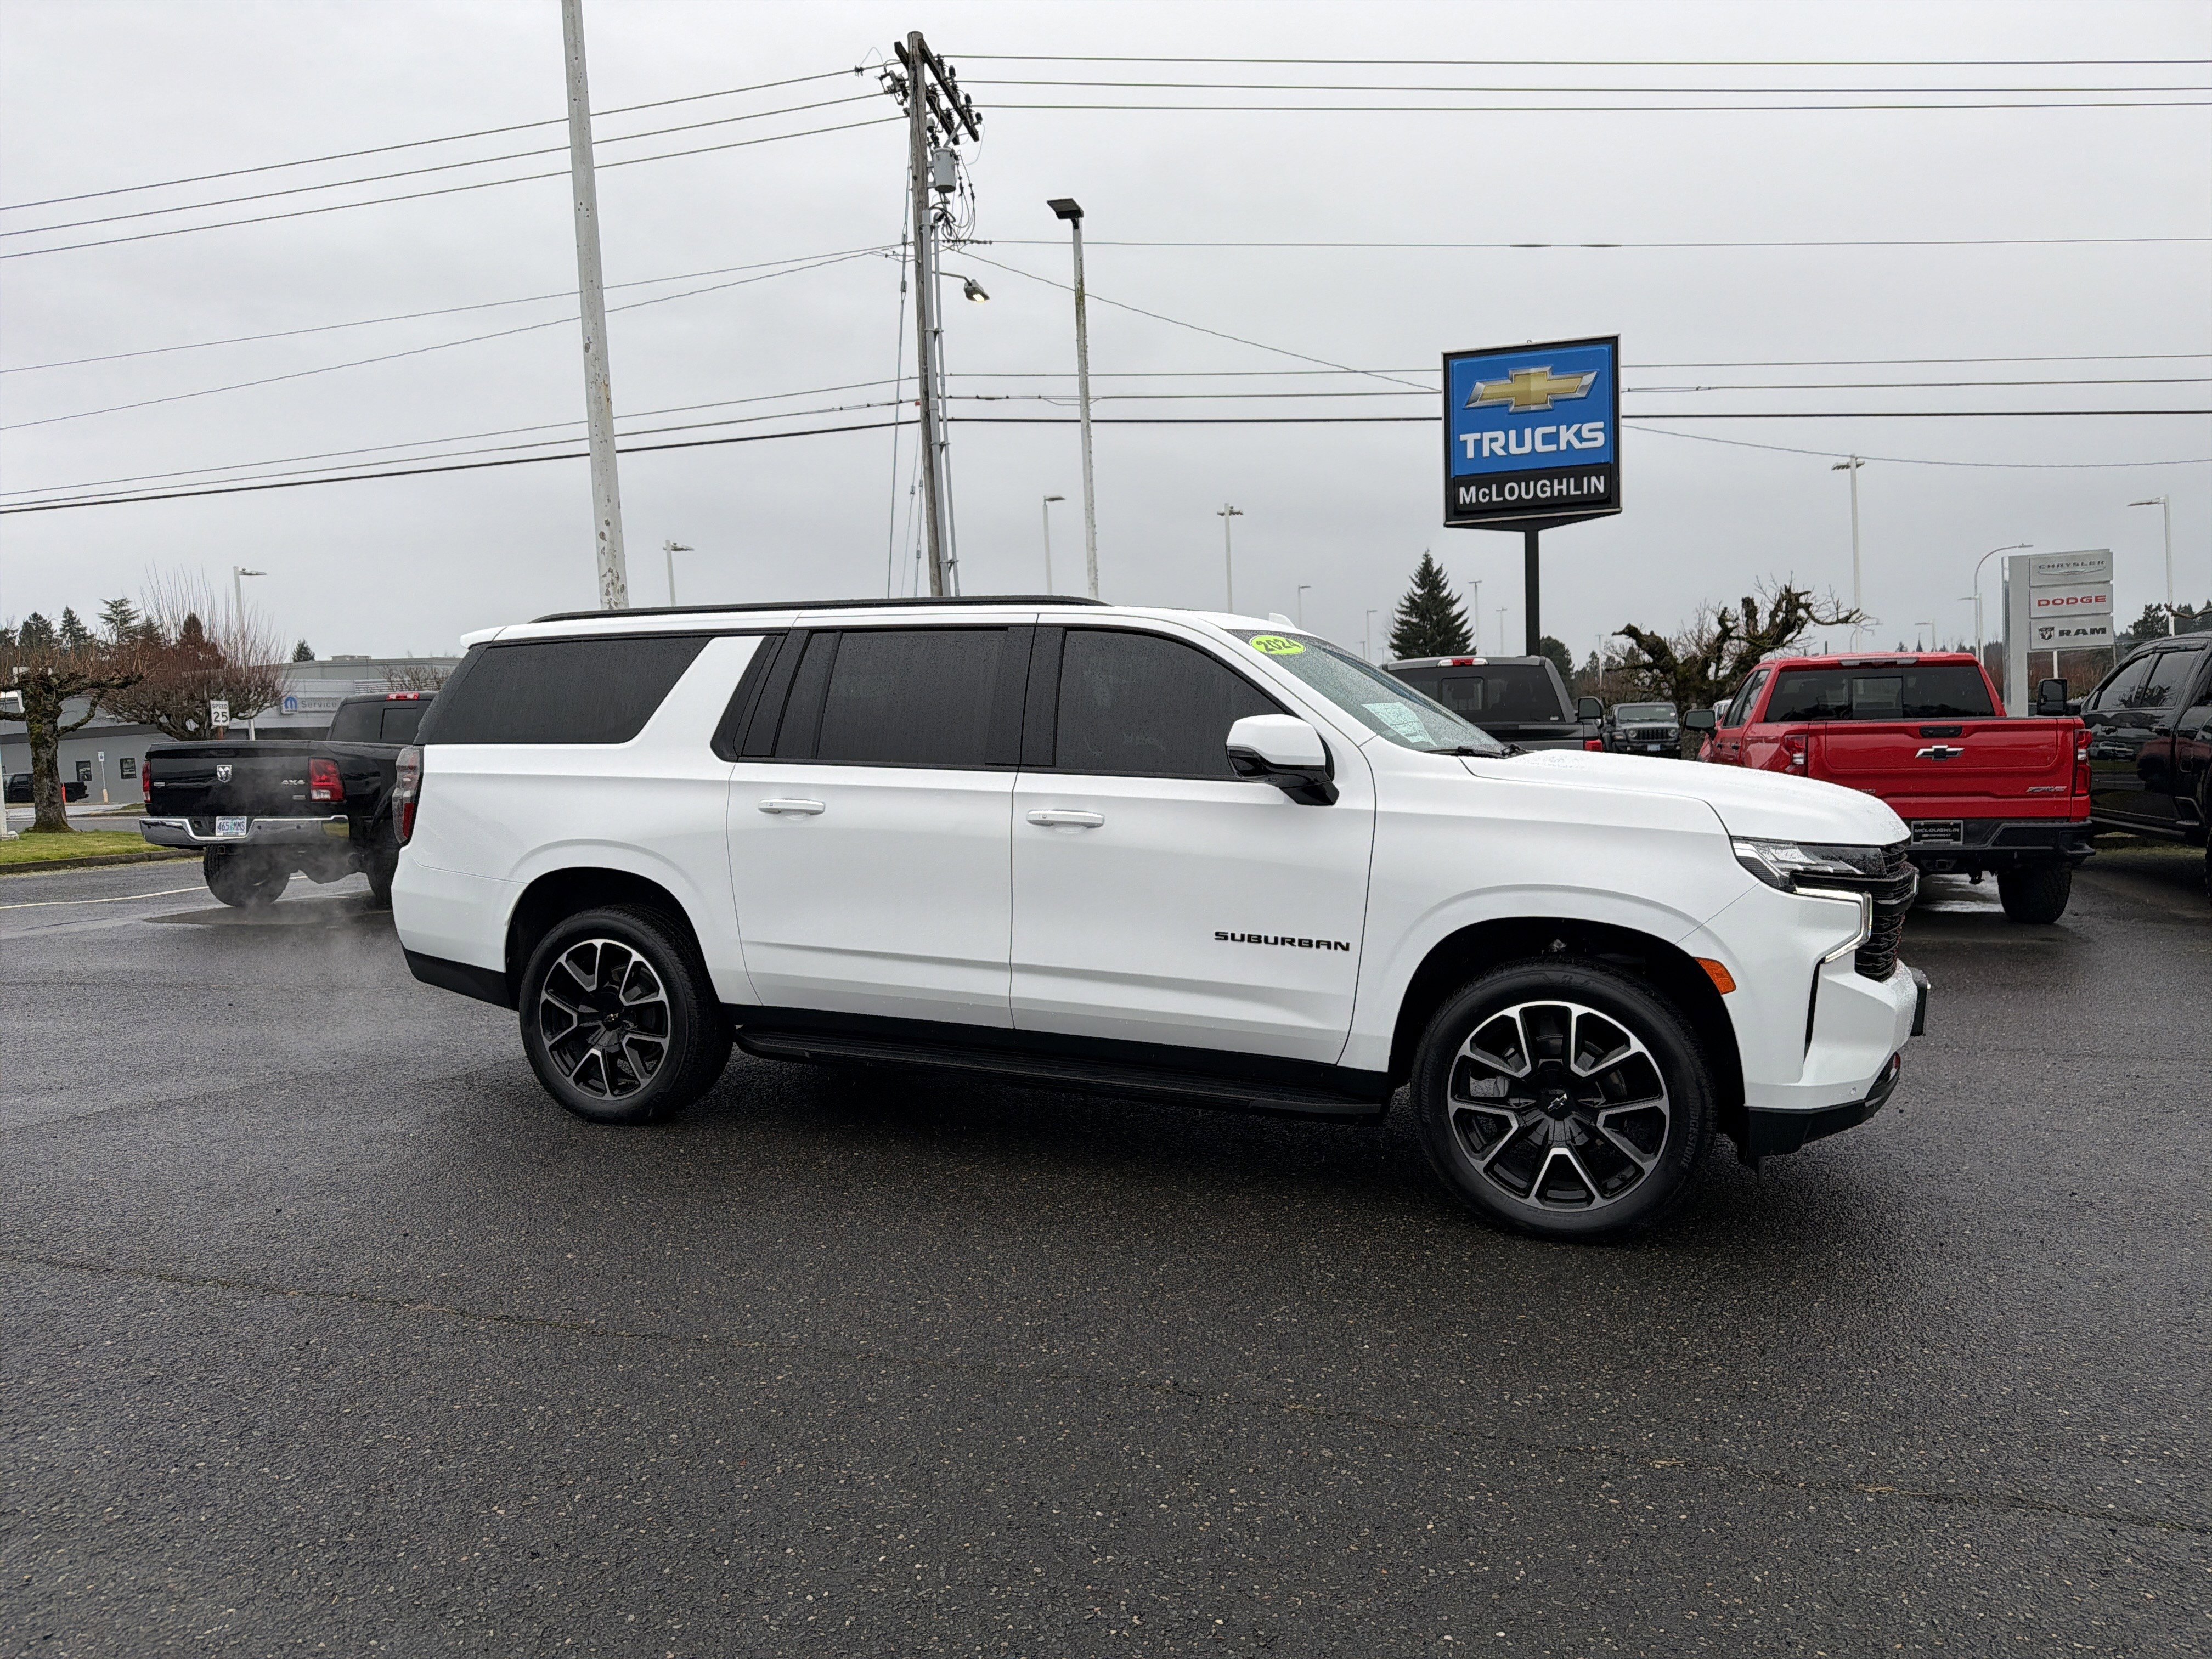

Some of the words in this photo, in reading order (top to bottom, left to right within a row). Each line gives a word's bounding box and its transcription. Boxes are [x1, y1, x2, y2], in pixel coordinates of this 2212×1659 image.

[1459, 421, 1605, 459] TRUCKS
[1459, 475, 1605, 505] McLOUGHLIN
[2039, 560, 2104, 569] CHRYSLER
[2038, 595, 2107, 607] DODGE
[2058, 627, 2107, 637] RAM
[1255, 639, 1302, 652] 2024
[301, 700, 336, 708] Service
[213, 711, 228, 723] 25
[1214, 931, 1350, 952] SUBURBAN
